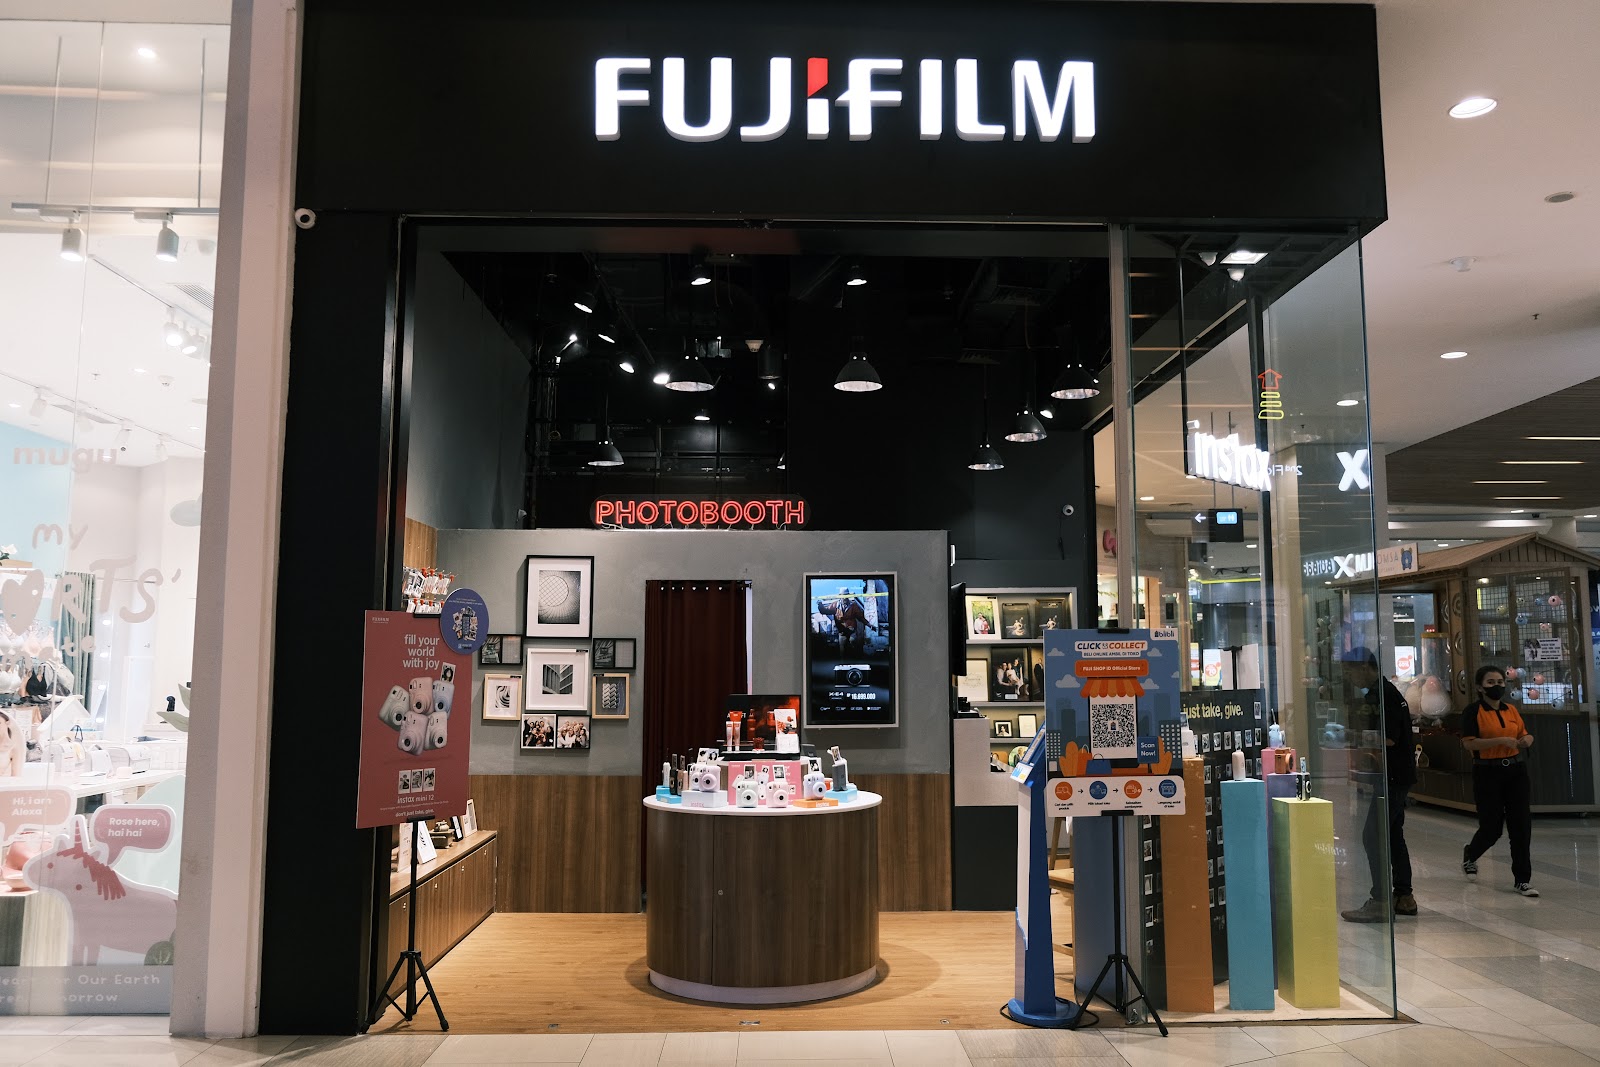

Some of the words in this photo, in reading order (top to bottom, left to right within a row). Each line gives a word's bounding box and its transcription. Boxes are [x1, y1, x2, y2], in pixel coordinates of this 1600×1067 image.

[595, 57, 1096, 142] FUJIFILM
[1185, 419, 1271, 491] instax
[596, 500, 804, 524] PHOTOBOOTH
[32, 523, 88, 550] my
[404, 634, 416, 644] fill
[418, 636, 439, 646] your
[408, 647, 435, 656] world
[403, 658, 423, 668] with
[425, 659, 440, 670] joy
[1202, 702, 1223, 719] take,
[1225, 701, 1244, 720] give.
[109, 817, 133, 825] Rose
[135, 817, 160, 827] here,
[108, 828, 124, 836] hai
[126, 828, 142, 836] hai
[78, 974, 106, 985] Our
[114, 974, 160, 985] Earth
